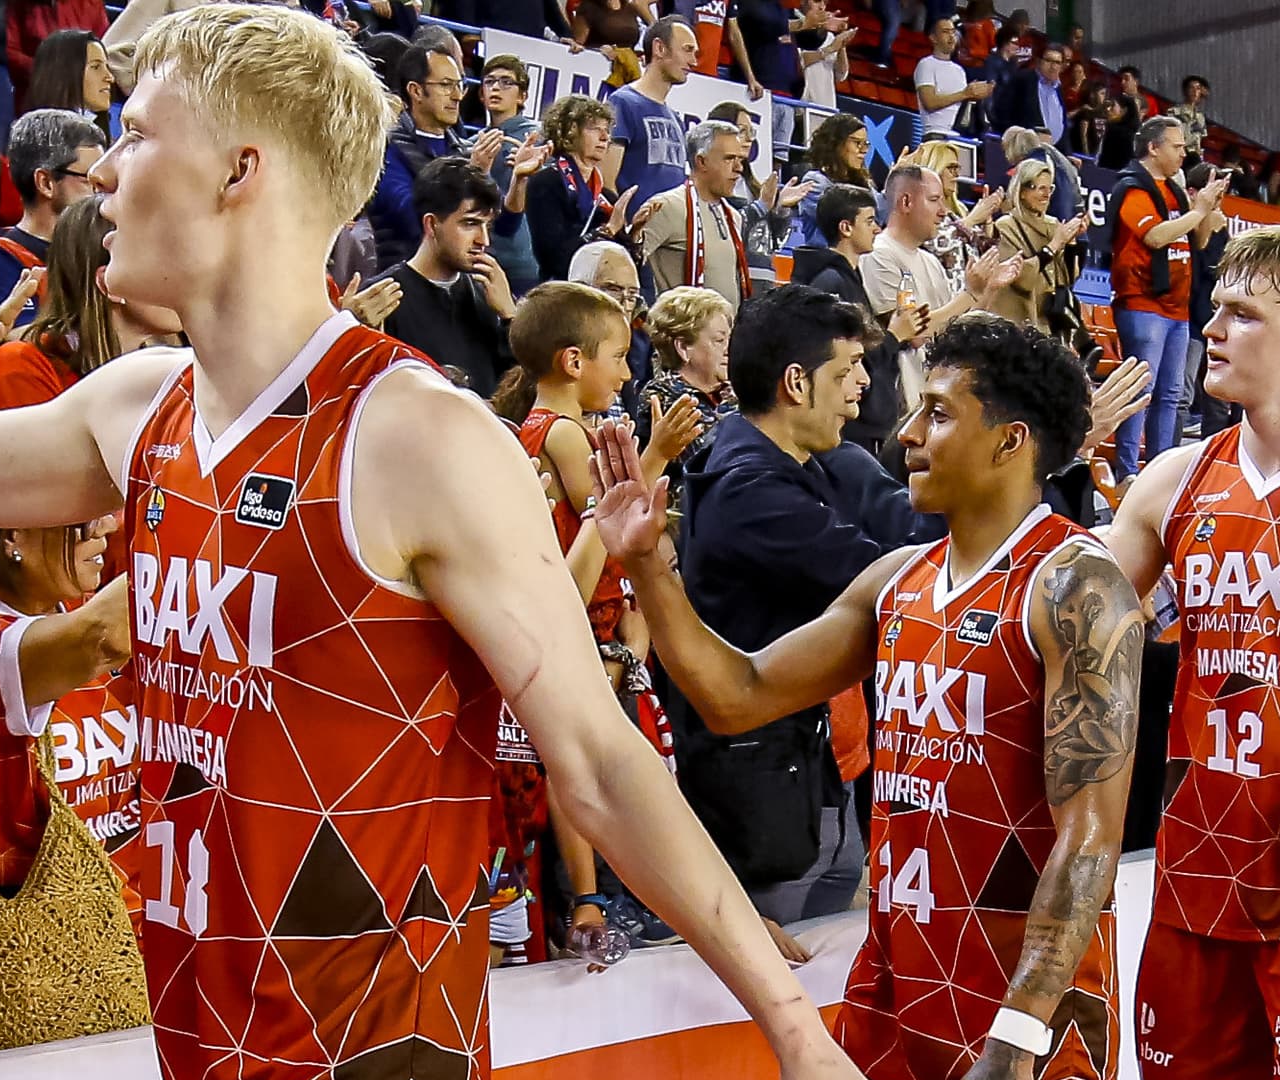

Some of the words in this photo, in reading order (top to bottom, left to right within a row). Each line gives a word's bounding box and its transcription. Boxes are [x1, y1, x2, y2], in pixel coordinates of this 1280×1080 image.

[240, 503, 282, 523] endesa
[133, 551, 278, 668] BAXI
[875, 660, 987, 736] BAXI
[1197, 648, 1279, 686] MANRESA
[1206, 708, 1264, 778] 12
